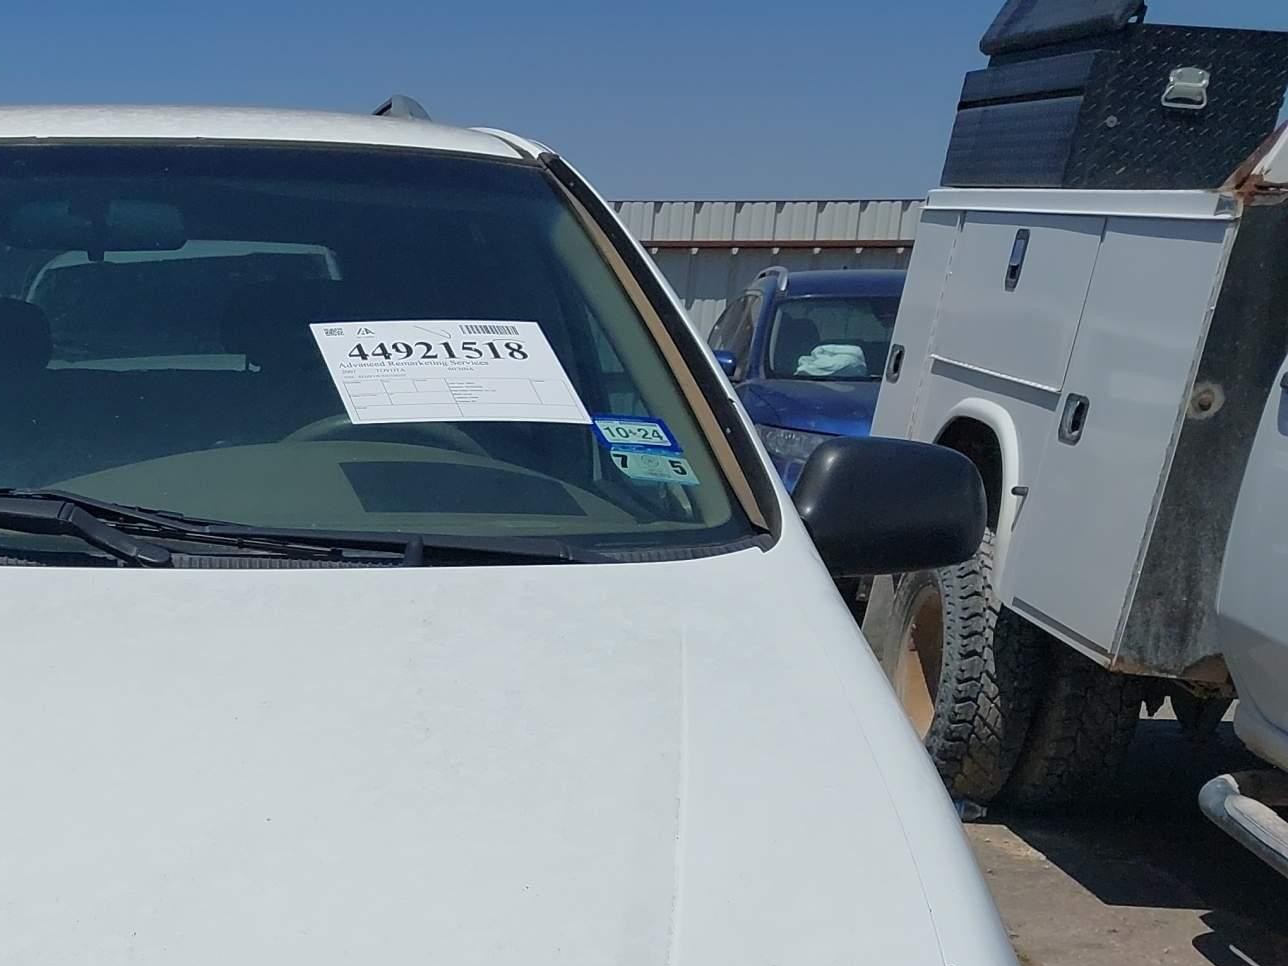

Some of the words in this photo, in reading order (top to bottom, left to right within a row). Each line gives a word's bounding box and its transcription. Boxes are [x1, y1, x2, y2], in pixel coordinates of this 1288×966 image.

[348, 341, 529, 361] 44921518
[339, 361, 386, 369] Advanced
[387, 360, 448, 368] Remarketing
[449, 359, 489, 367] Services
[612, 453, 628, 469] 7
[668, 459, 688, 476] 5
